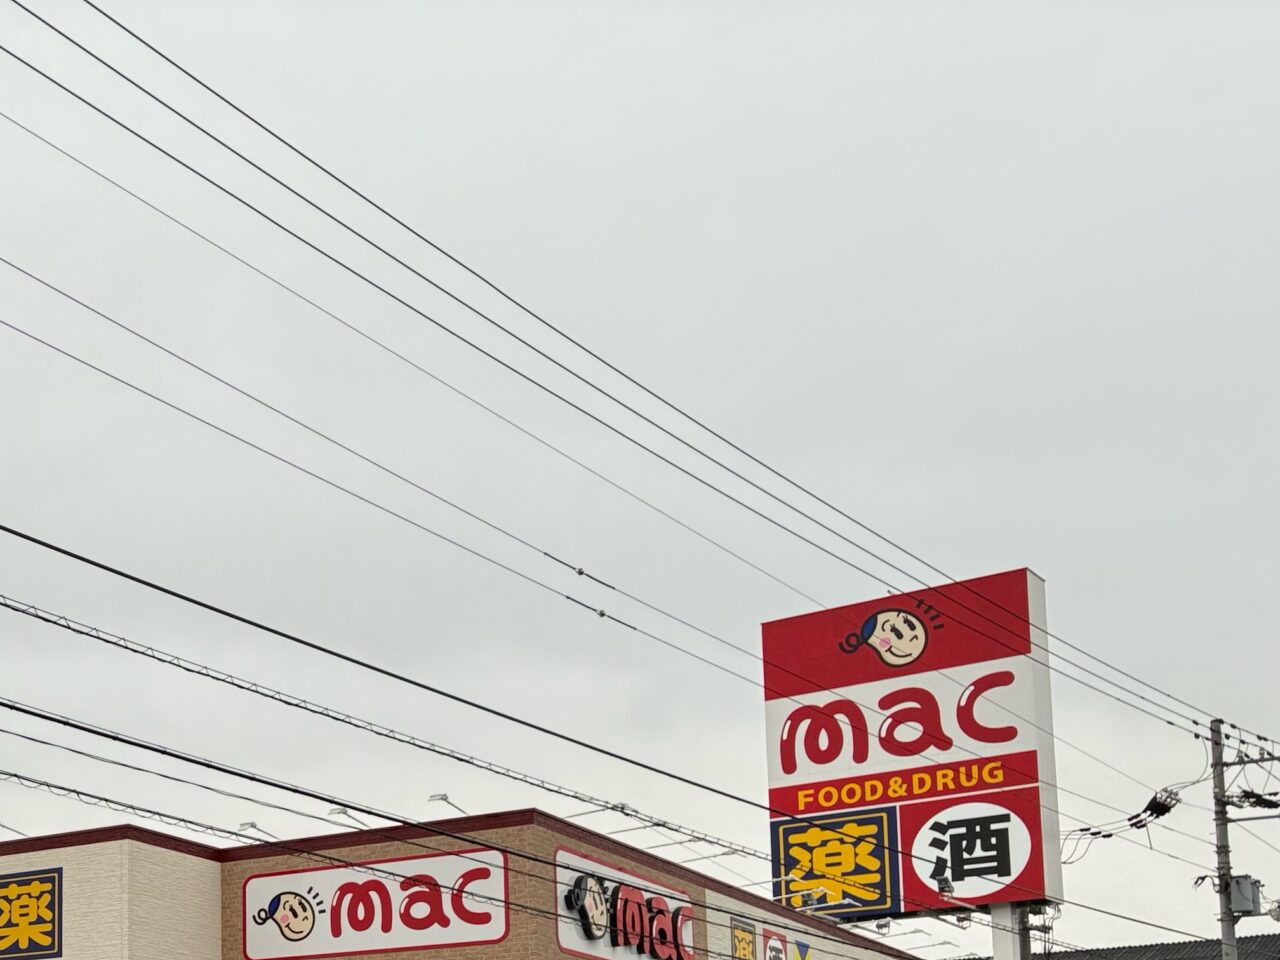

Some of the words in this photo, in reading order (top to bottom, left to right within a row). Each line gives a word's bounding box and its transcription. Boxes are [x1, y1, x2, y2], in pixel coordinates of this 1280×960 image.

[779, 670, 1019, 776] mac
[797, 761, 1005, 811] FOOD&DRUG
[788, 822, 883, 908] 薬
[928, 812, 1012, 883] 酒
[330, 866, 493, 939] mac
